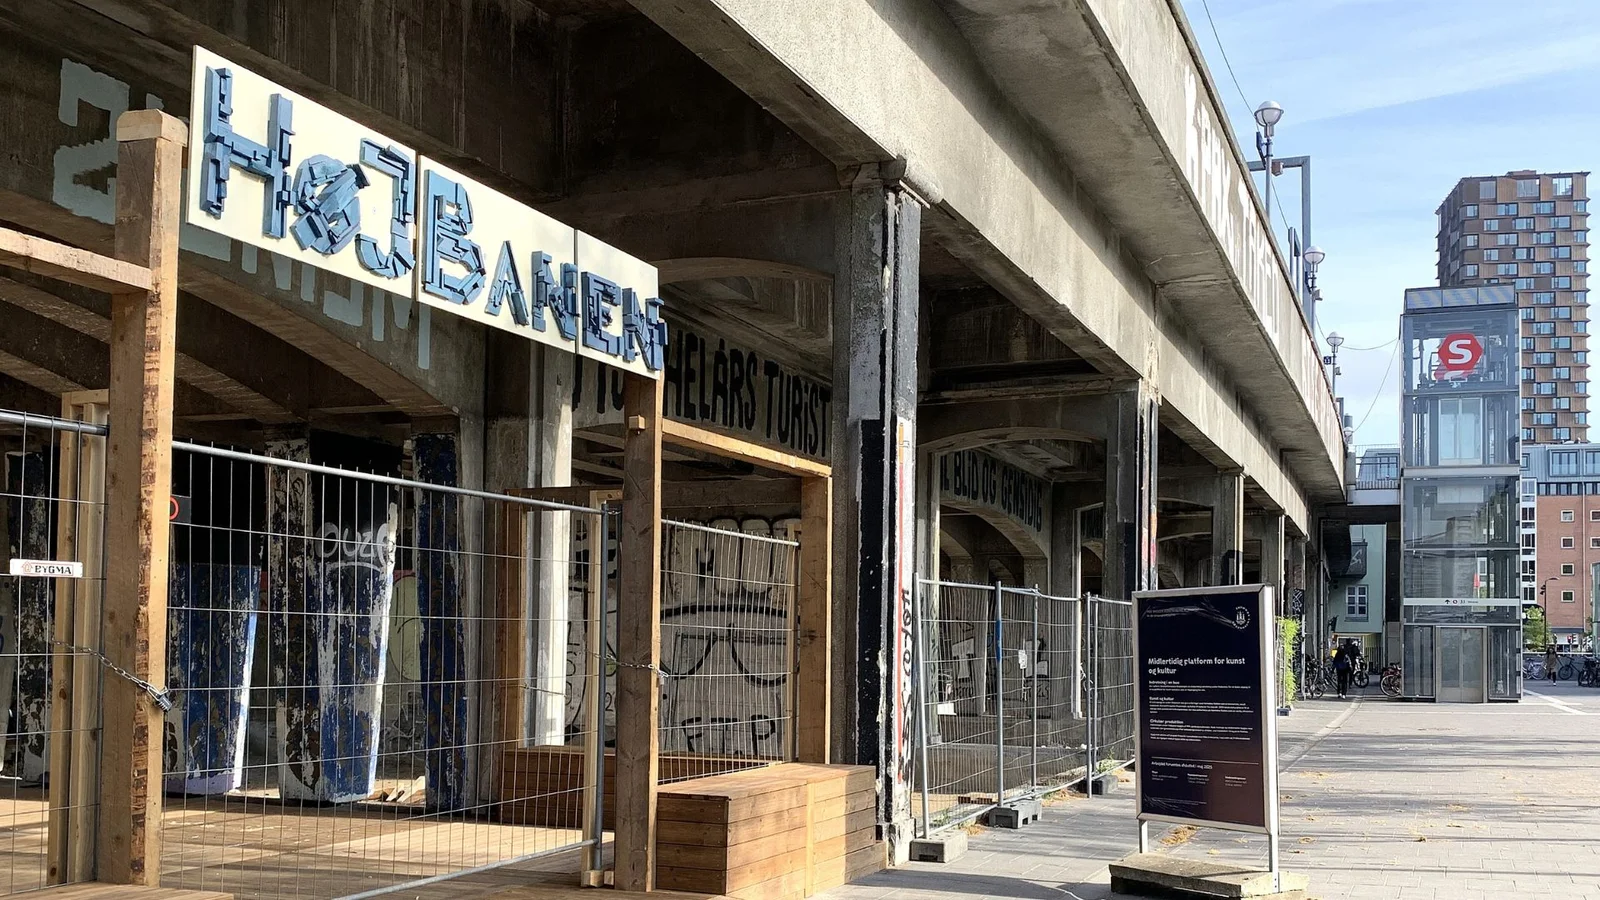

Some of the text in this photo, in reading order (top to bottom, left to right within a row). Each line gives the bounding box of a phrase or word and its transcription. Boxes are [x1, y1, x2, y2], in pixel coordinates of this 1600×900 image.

[1448, 339, 1473, 364] S
[35, 565, 71, 574] BYGMA
[1148, 658, 1183, 666] Midlertidig
[1184, 657, 1213, 666] platform
[1214, 657, 1225, 665] for
